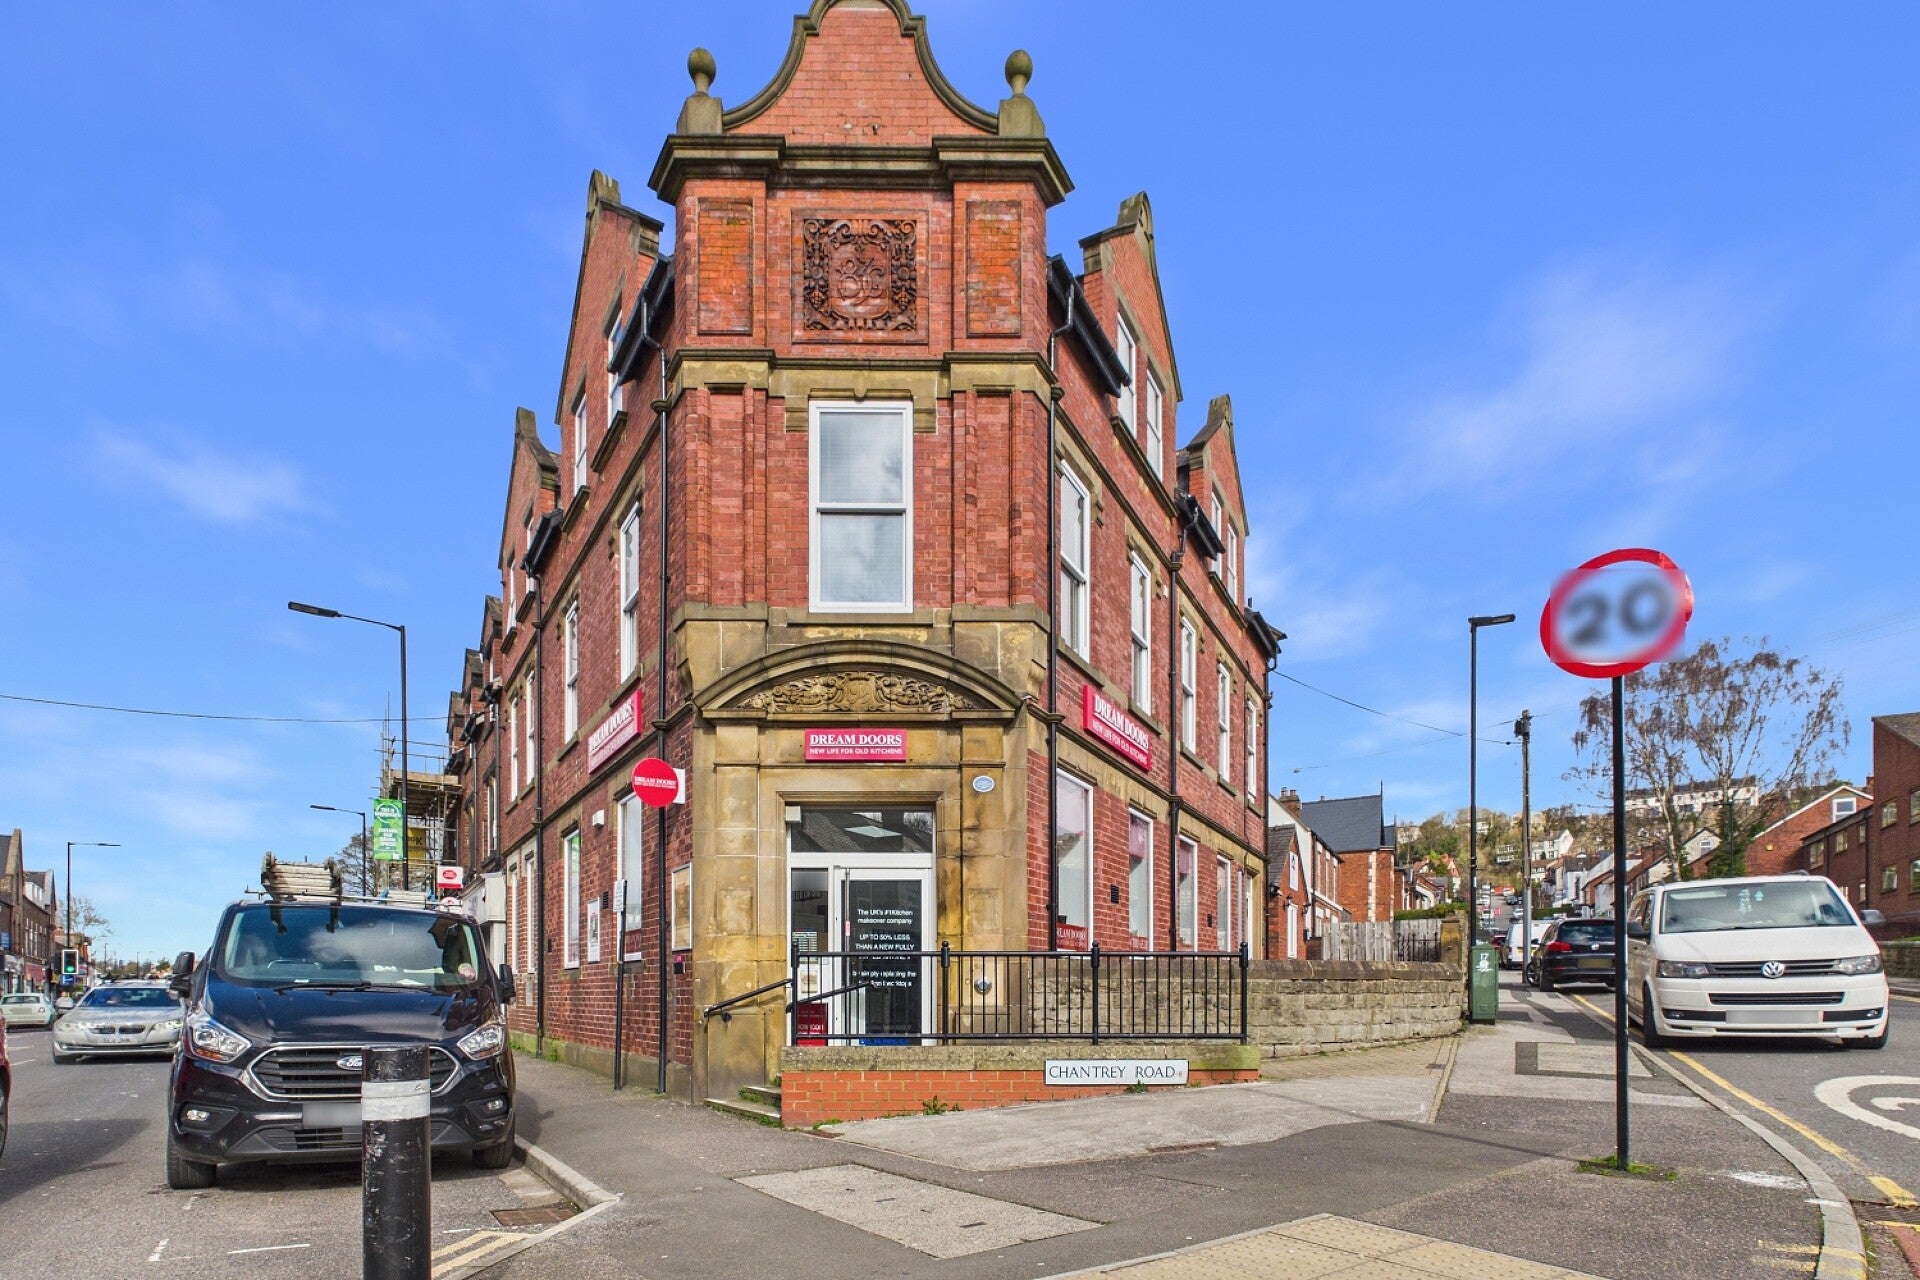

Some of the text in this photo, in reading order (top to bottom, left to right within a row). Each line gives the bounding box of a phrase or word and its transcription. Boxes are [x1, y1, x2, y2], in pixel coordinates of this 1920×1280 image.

[1567, 577, 1675, 647] 20
[1094, 694, 1149, 749] DREAM DOORS
[810, 734, 902, 744] DREAM DOORS
[656, 778, 677, 786] DOORS
[1048, 1065, 1126, 1079] CHANTREY
[1134, 1065, 1175, 1079] ROAD
